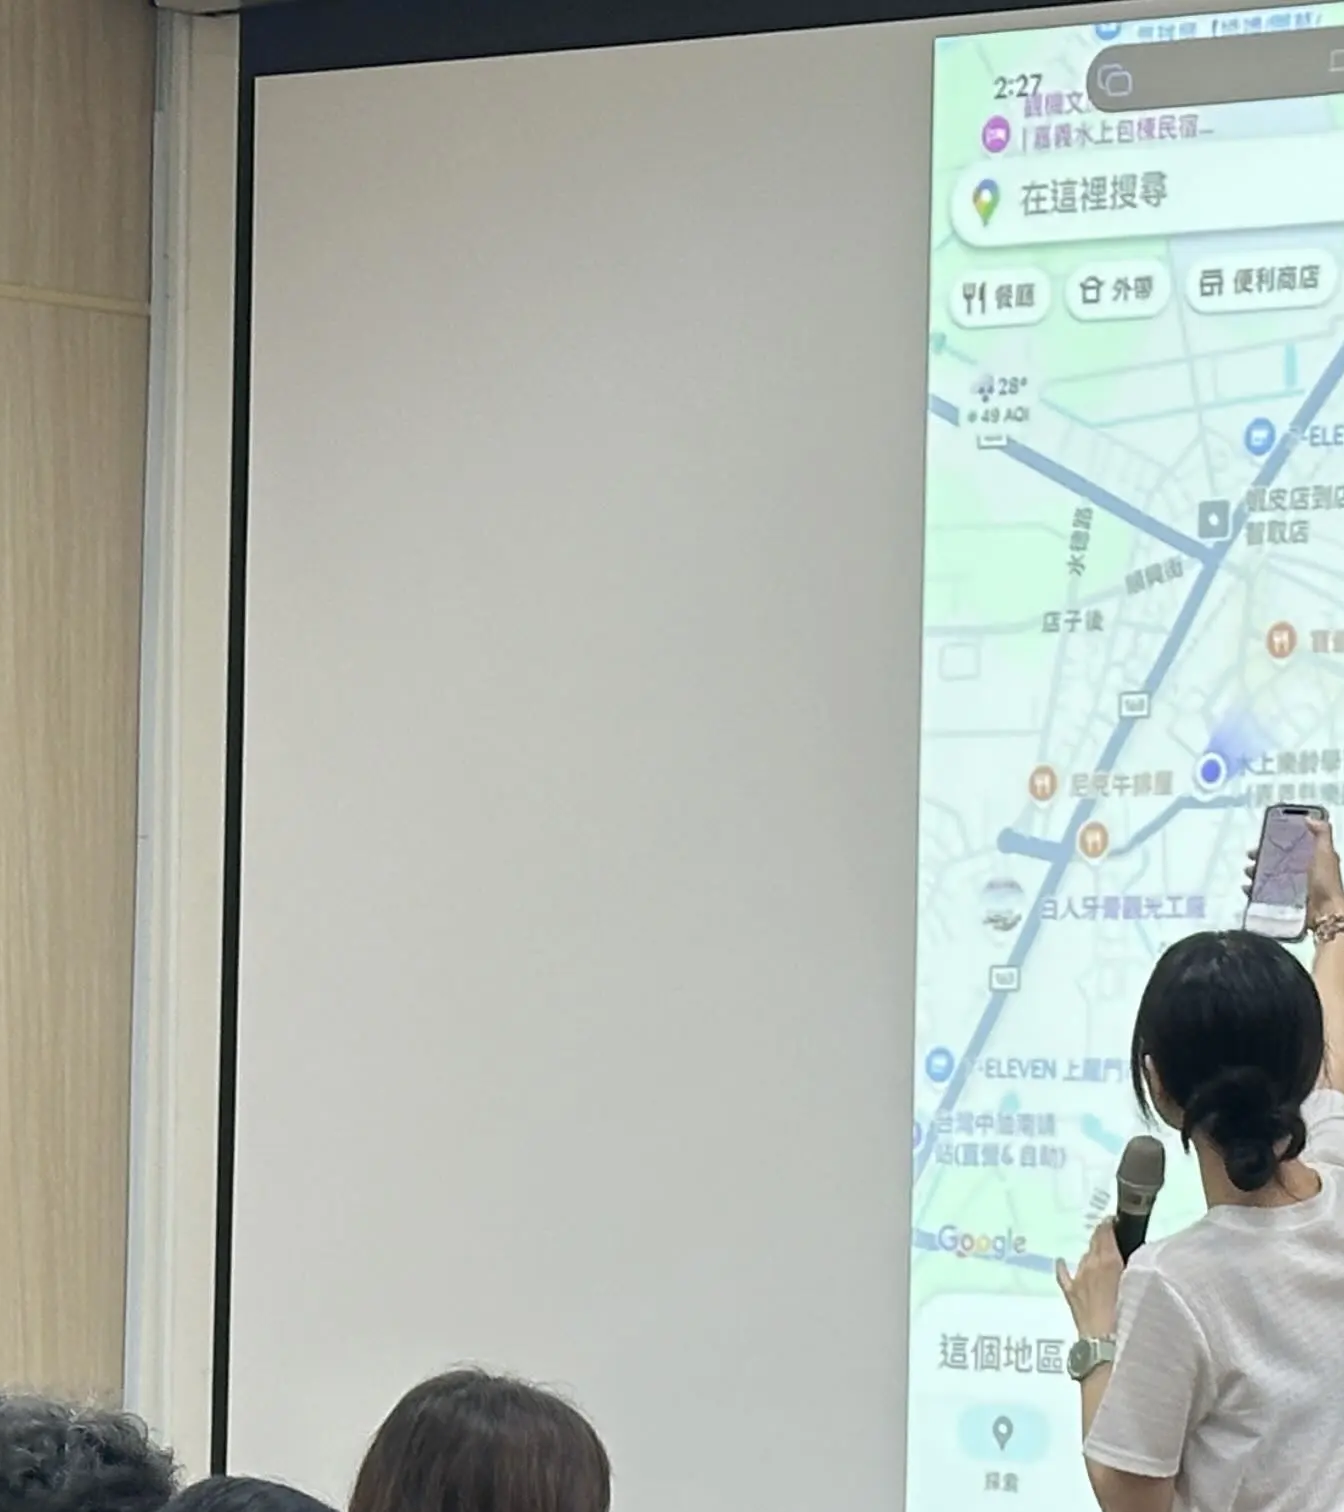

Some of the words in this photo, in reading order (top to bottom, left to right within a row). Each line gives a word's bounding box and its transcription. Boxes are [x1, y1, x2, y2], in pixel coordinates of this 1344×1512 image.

[993, 73, 1043, 100] 2:27
[1020, 170, 1168, 217] 在這裡搜尋
[1112, 275, 1154, 303] 外帶
[1233, 264, 1321, 295] 便利商店
[994, 282, 1036, 310] 餐廳
[937, 1222, 1028, 1259] Google
[937, 1332, 1066, 1375] 這個地區
